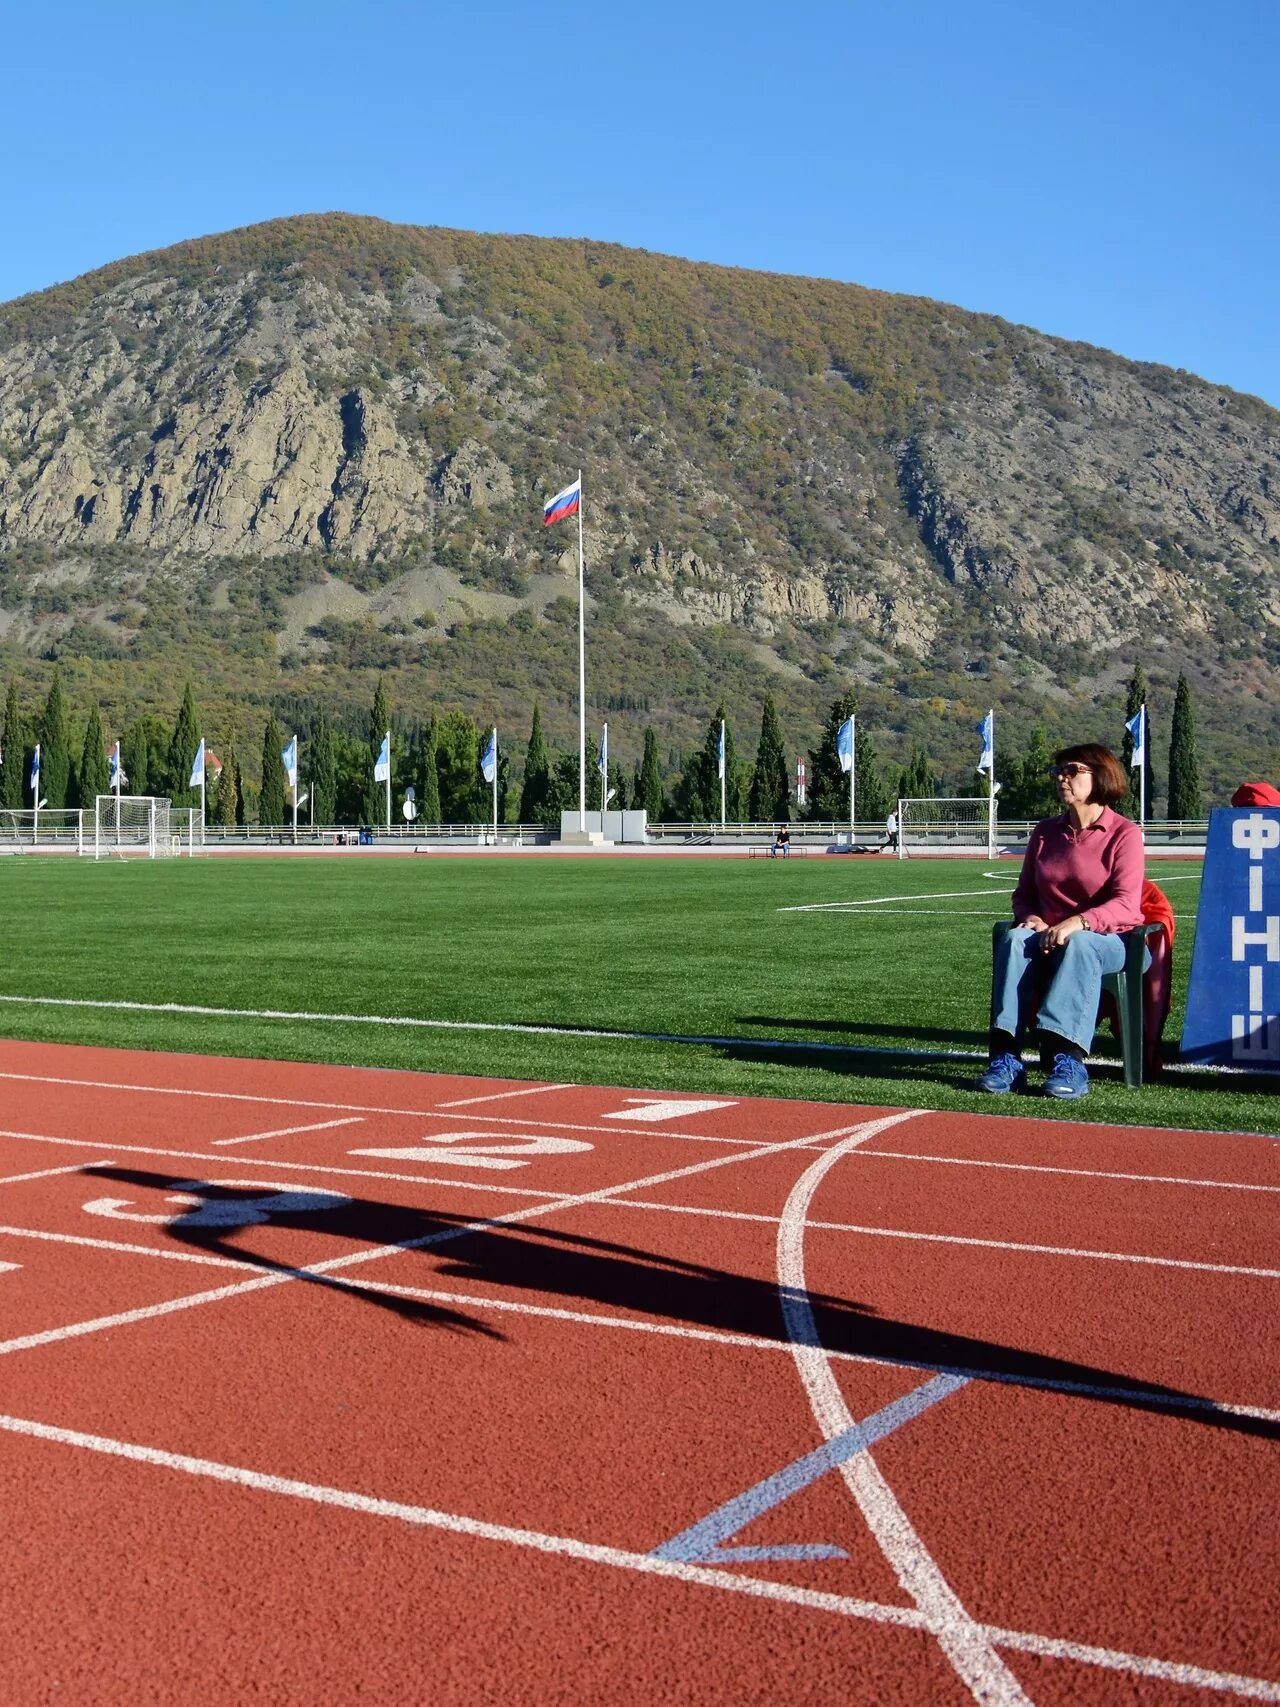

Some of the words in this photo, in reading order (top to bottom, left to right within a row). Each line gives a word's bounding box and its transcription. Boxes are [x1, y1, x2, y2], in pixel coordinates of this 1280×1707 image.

[1232, 813, 1280, 1060] ФІНІШ
[601, 1098, 740, 1121] 1
[347, 1132, 595, 1169] 2
[81, 1179, 356, 1226] 3
